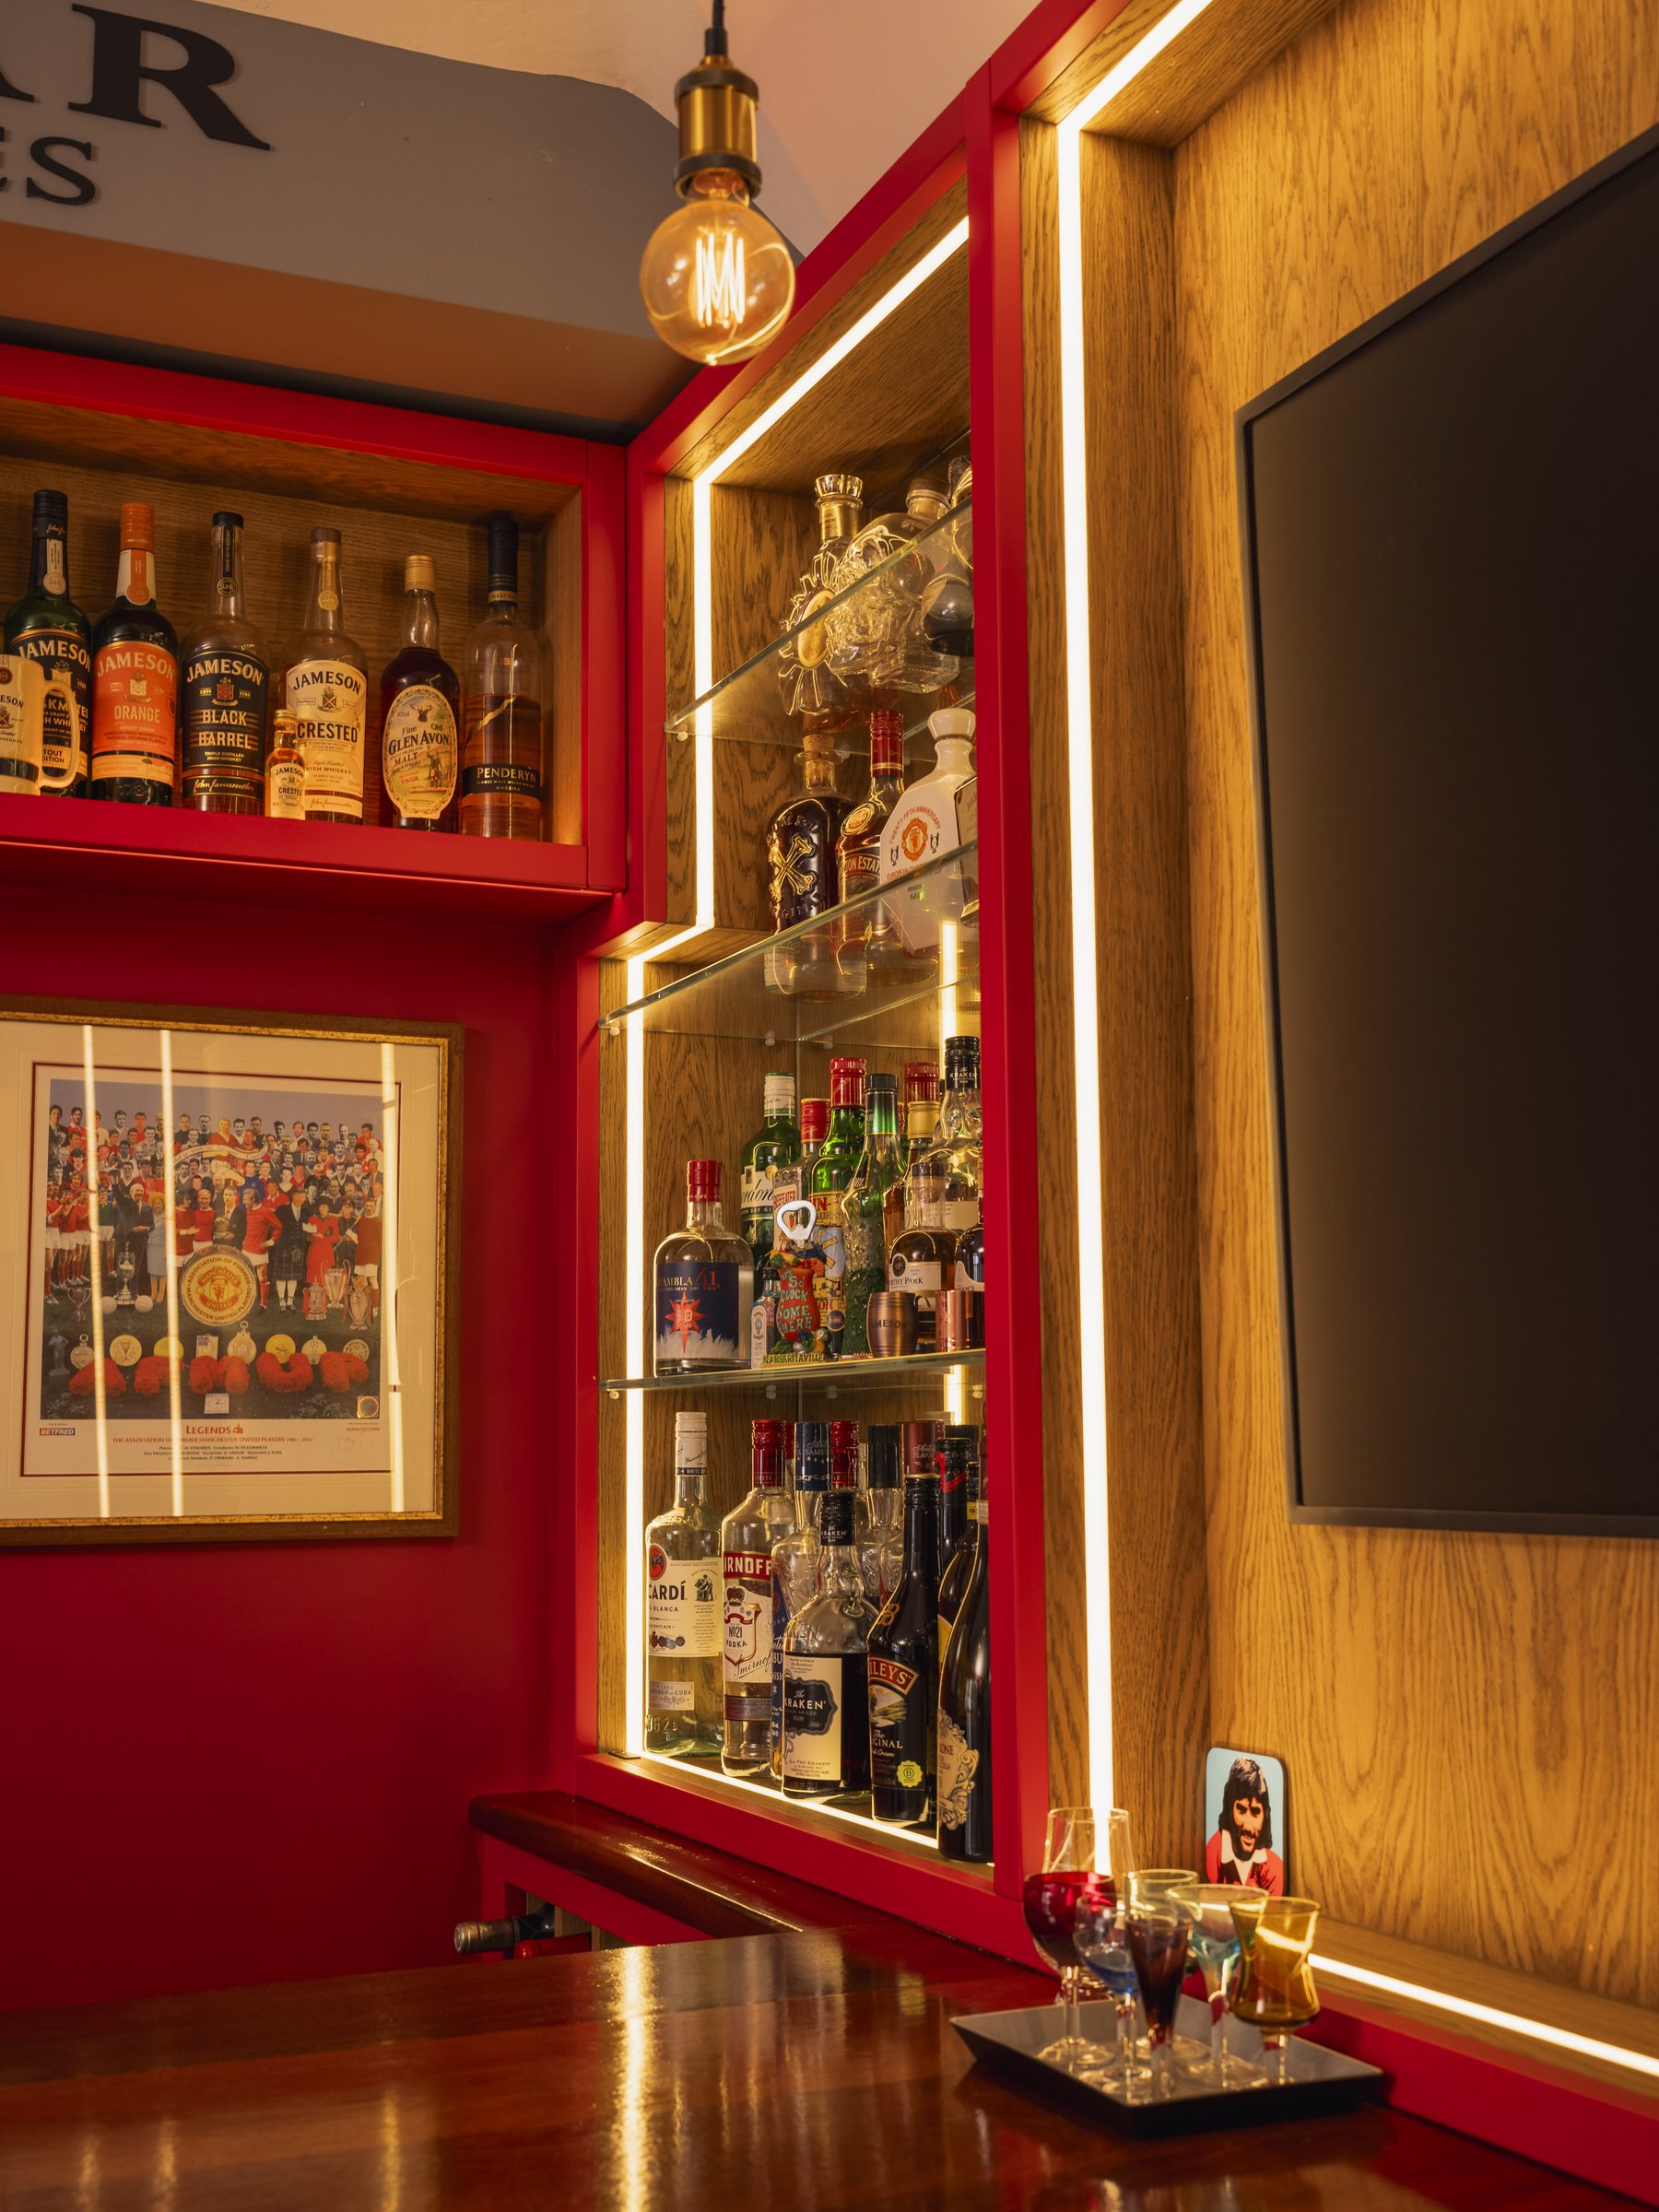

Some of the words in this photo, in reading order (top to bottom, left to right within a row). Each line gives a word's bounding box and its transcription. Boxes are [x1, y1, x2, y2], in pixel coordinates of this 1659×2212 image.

[0, 4, 270, 150] R
[0, 126, 96, 205] S
[18, 640, 90, 673] JAMESON
[98, 652, 175, 682] JAMESON
[187, 659, 264, 686] JAMESON
[293, 671, 360, 695] JAMESON
[114, 705, 160, 724] ORANGE
[202, 709, 247, 726] BLACK
[297, 723, 358, 743] CRESTED
[402, 726, 418, 735] Fine
[430, 723, 442, 731] Old
[198, 731, 252, 749] BARREL
[388, 734, 418, 756] GLEN
[419, 729, 450, 747] AVON
[42, 756, 65, 764] DITION
[43, 749, 63, 758] TOUT
[394, 752, 418, 766] MALT
[477, 767, 536, 782] PENDERYN
[889, 818, 903, 844] TWENTY
[916, 806, 941, 830] ANNIVERSARY
[773, 1190, 796, 1211] BEEFEATER
[187, 1257, 222, 1284] ASSOCIATION
[232, 1261, 252, 1285] FORMER
[663, 1277, 693, 1286] AMBLA
[788, 1275, 798, 1288] 5
[904, 1276, 924, 1285] PARK
[186, 1287, 214, 1320] MANCHESTER
[214, 1311, 239, 1321] UNITED
[239, 1287, 252, 1312] PLAYERS
[206, 1300, 233, 1309] UNITED
[778, 1304, 810, 1320] SOME
[762, 1352, 825, 1364] MARGARITAVILLE
[726, 1640, 747, 1648] VODKA
[794, 1688, 806, 1699] The
[784, 1698, 823, 1710] KRAKEN
[872, 1729, 885, 1739] The
